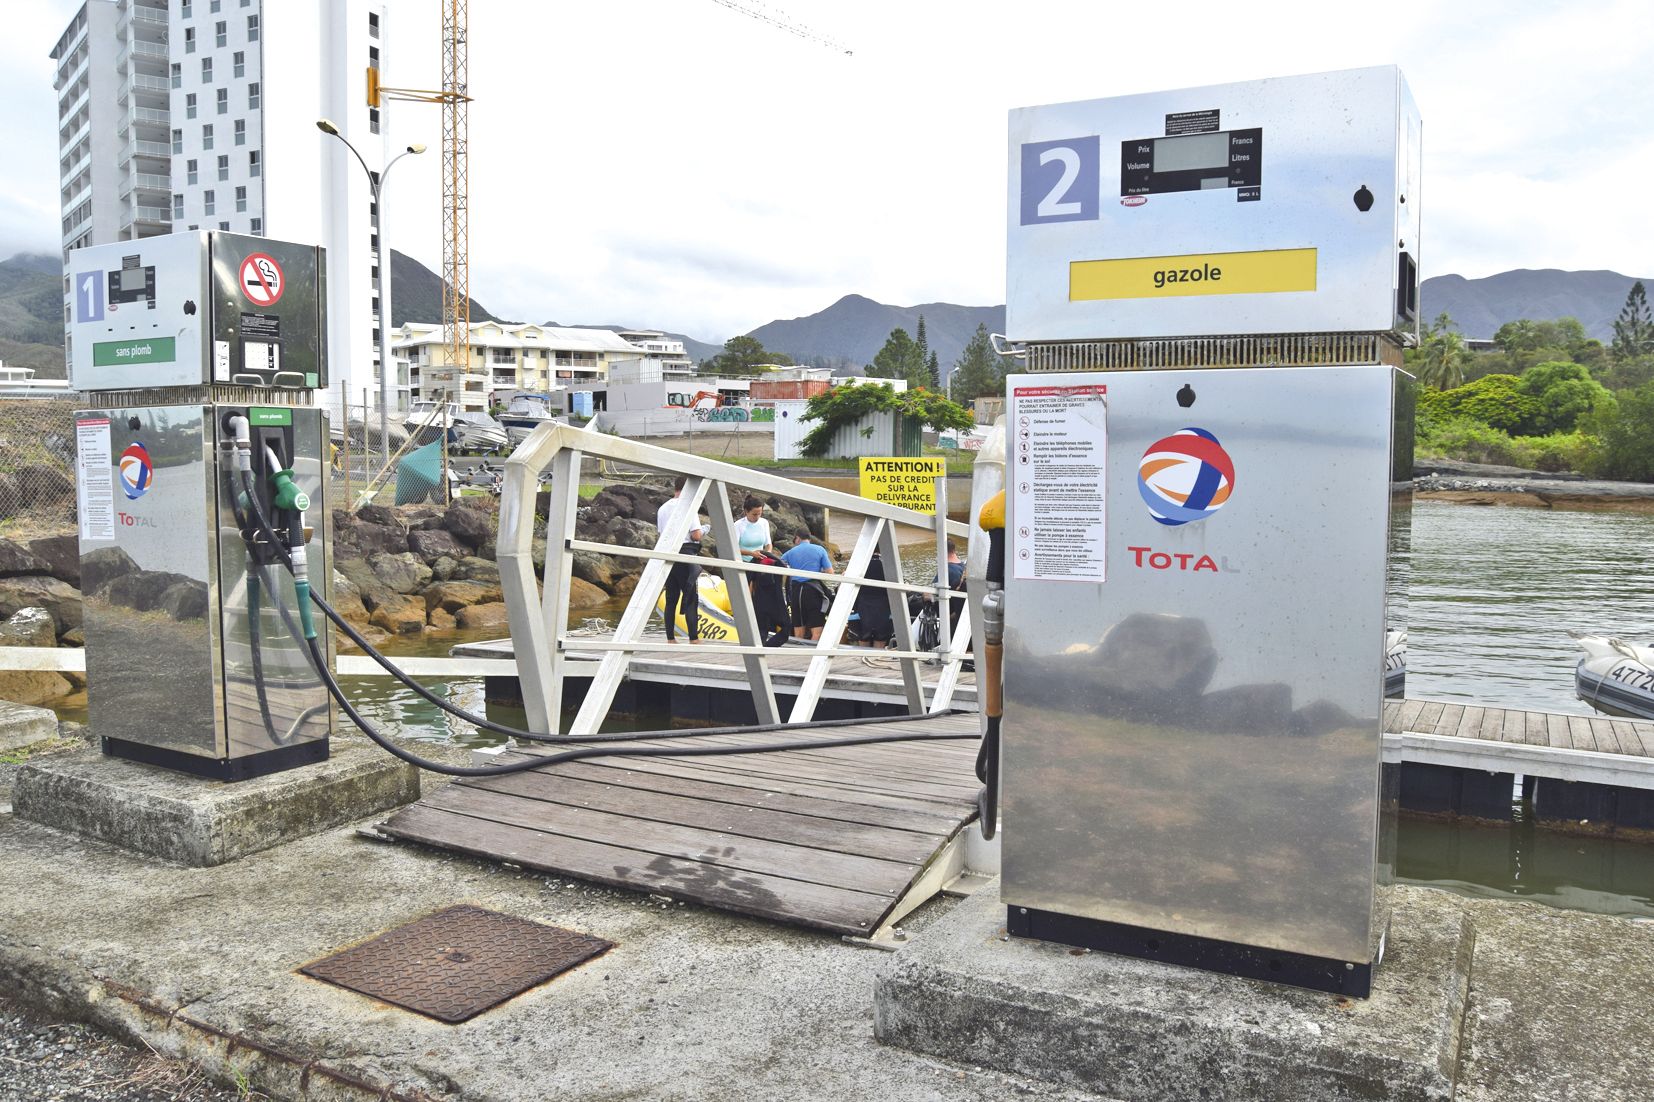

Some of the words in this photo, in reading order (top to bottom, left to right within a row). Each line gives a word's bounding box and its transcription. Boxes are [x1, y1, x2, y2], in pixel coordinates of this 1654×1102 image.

[1232, 154, 1250, 162] Litres
[1127, 162, 1150, 170] Volume
[1038, 147, 1081, 216] 2
[1154, 263, 1222, 288] gazole
[82, 276, 94, 318] 1
[116, 348, 130, 357] sans
[131, 344, 152, 358] plomb
[865, 462, 933, 473] ATTENTION
[936, 462, 940, 472] !
[870, 475, 887, 483] PAS
[888, 484, 904, 492] SUR
[876, 493, 931, 501] DELIVRANCE
[1128, 546, 1240, 574] TOTAL
